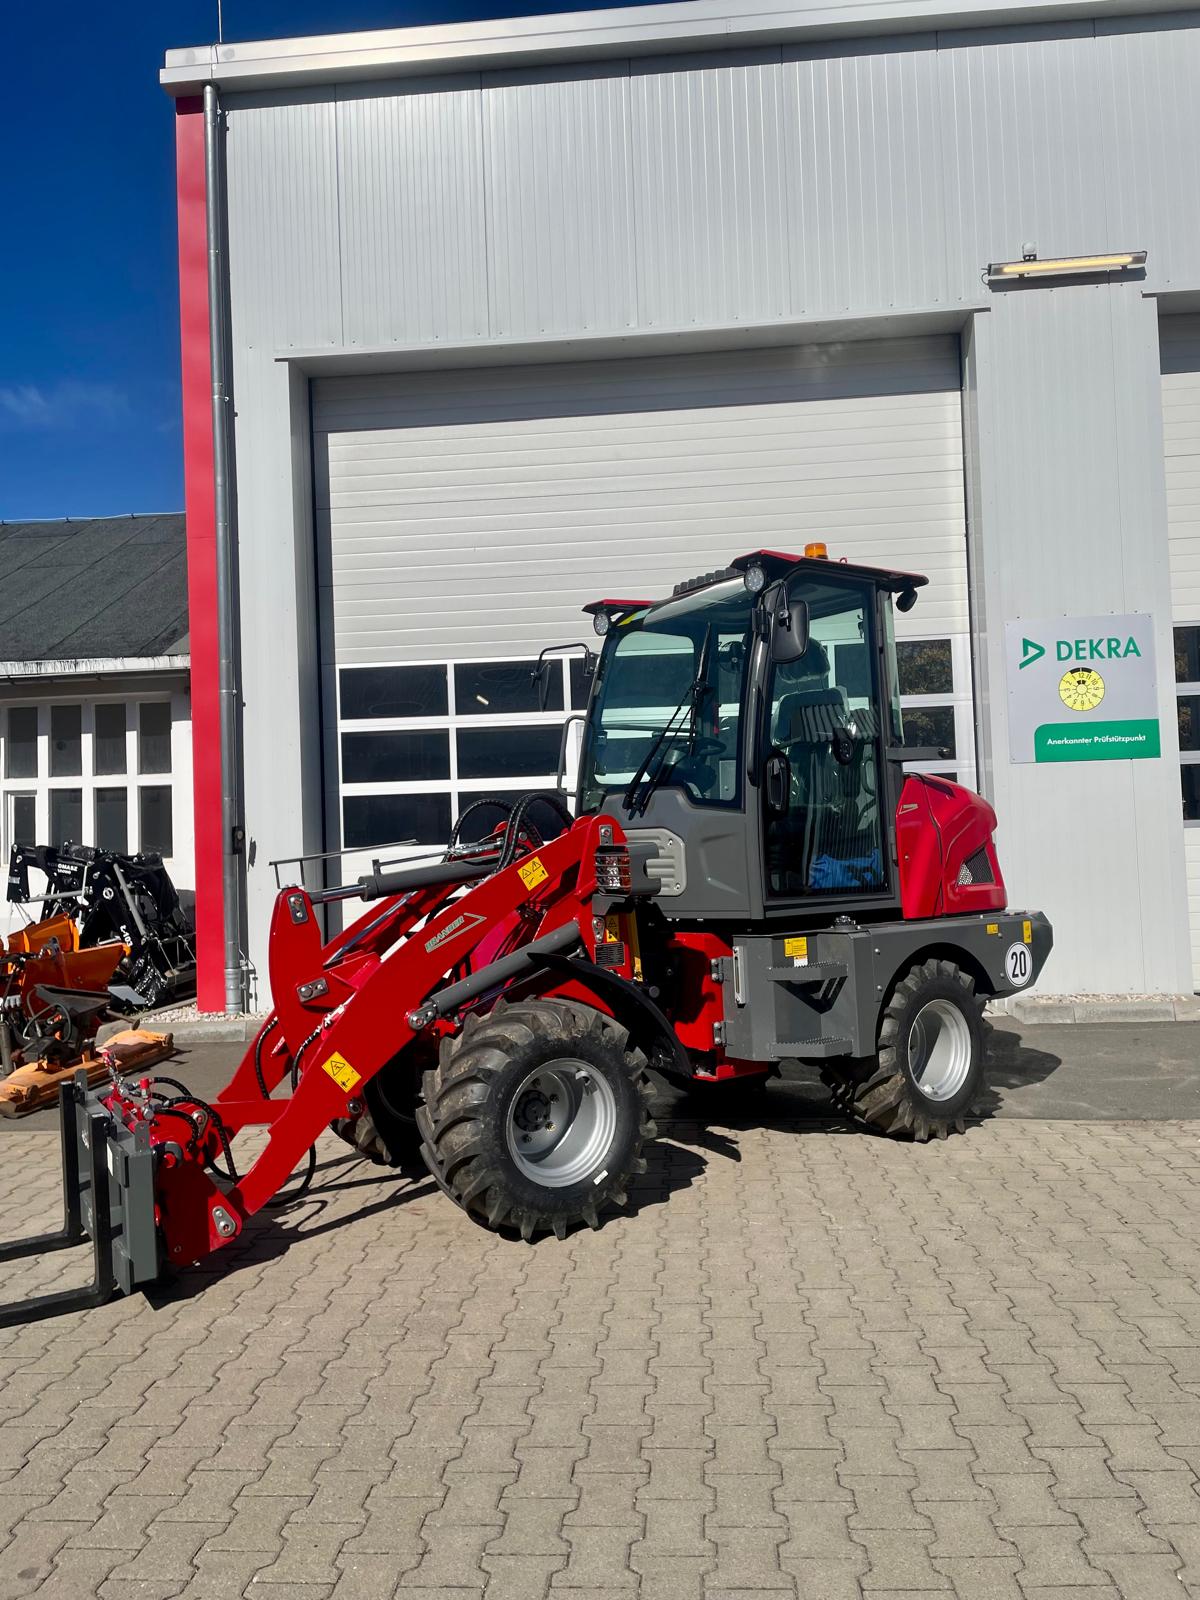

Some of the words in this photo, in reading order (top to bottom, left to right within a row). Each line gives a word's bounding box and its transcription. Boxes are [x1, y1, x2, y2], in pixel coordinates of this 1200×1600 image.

[1056, 636, 1142, 661] DEKRA
[1047, 737, 1092, 745] Anerkannter
[1094, 734, 1146, 744] Prüfstützpunkt
[1011, 951, 1027, 978] 20
